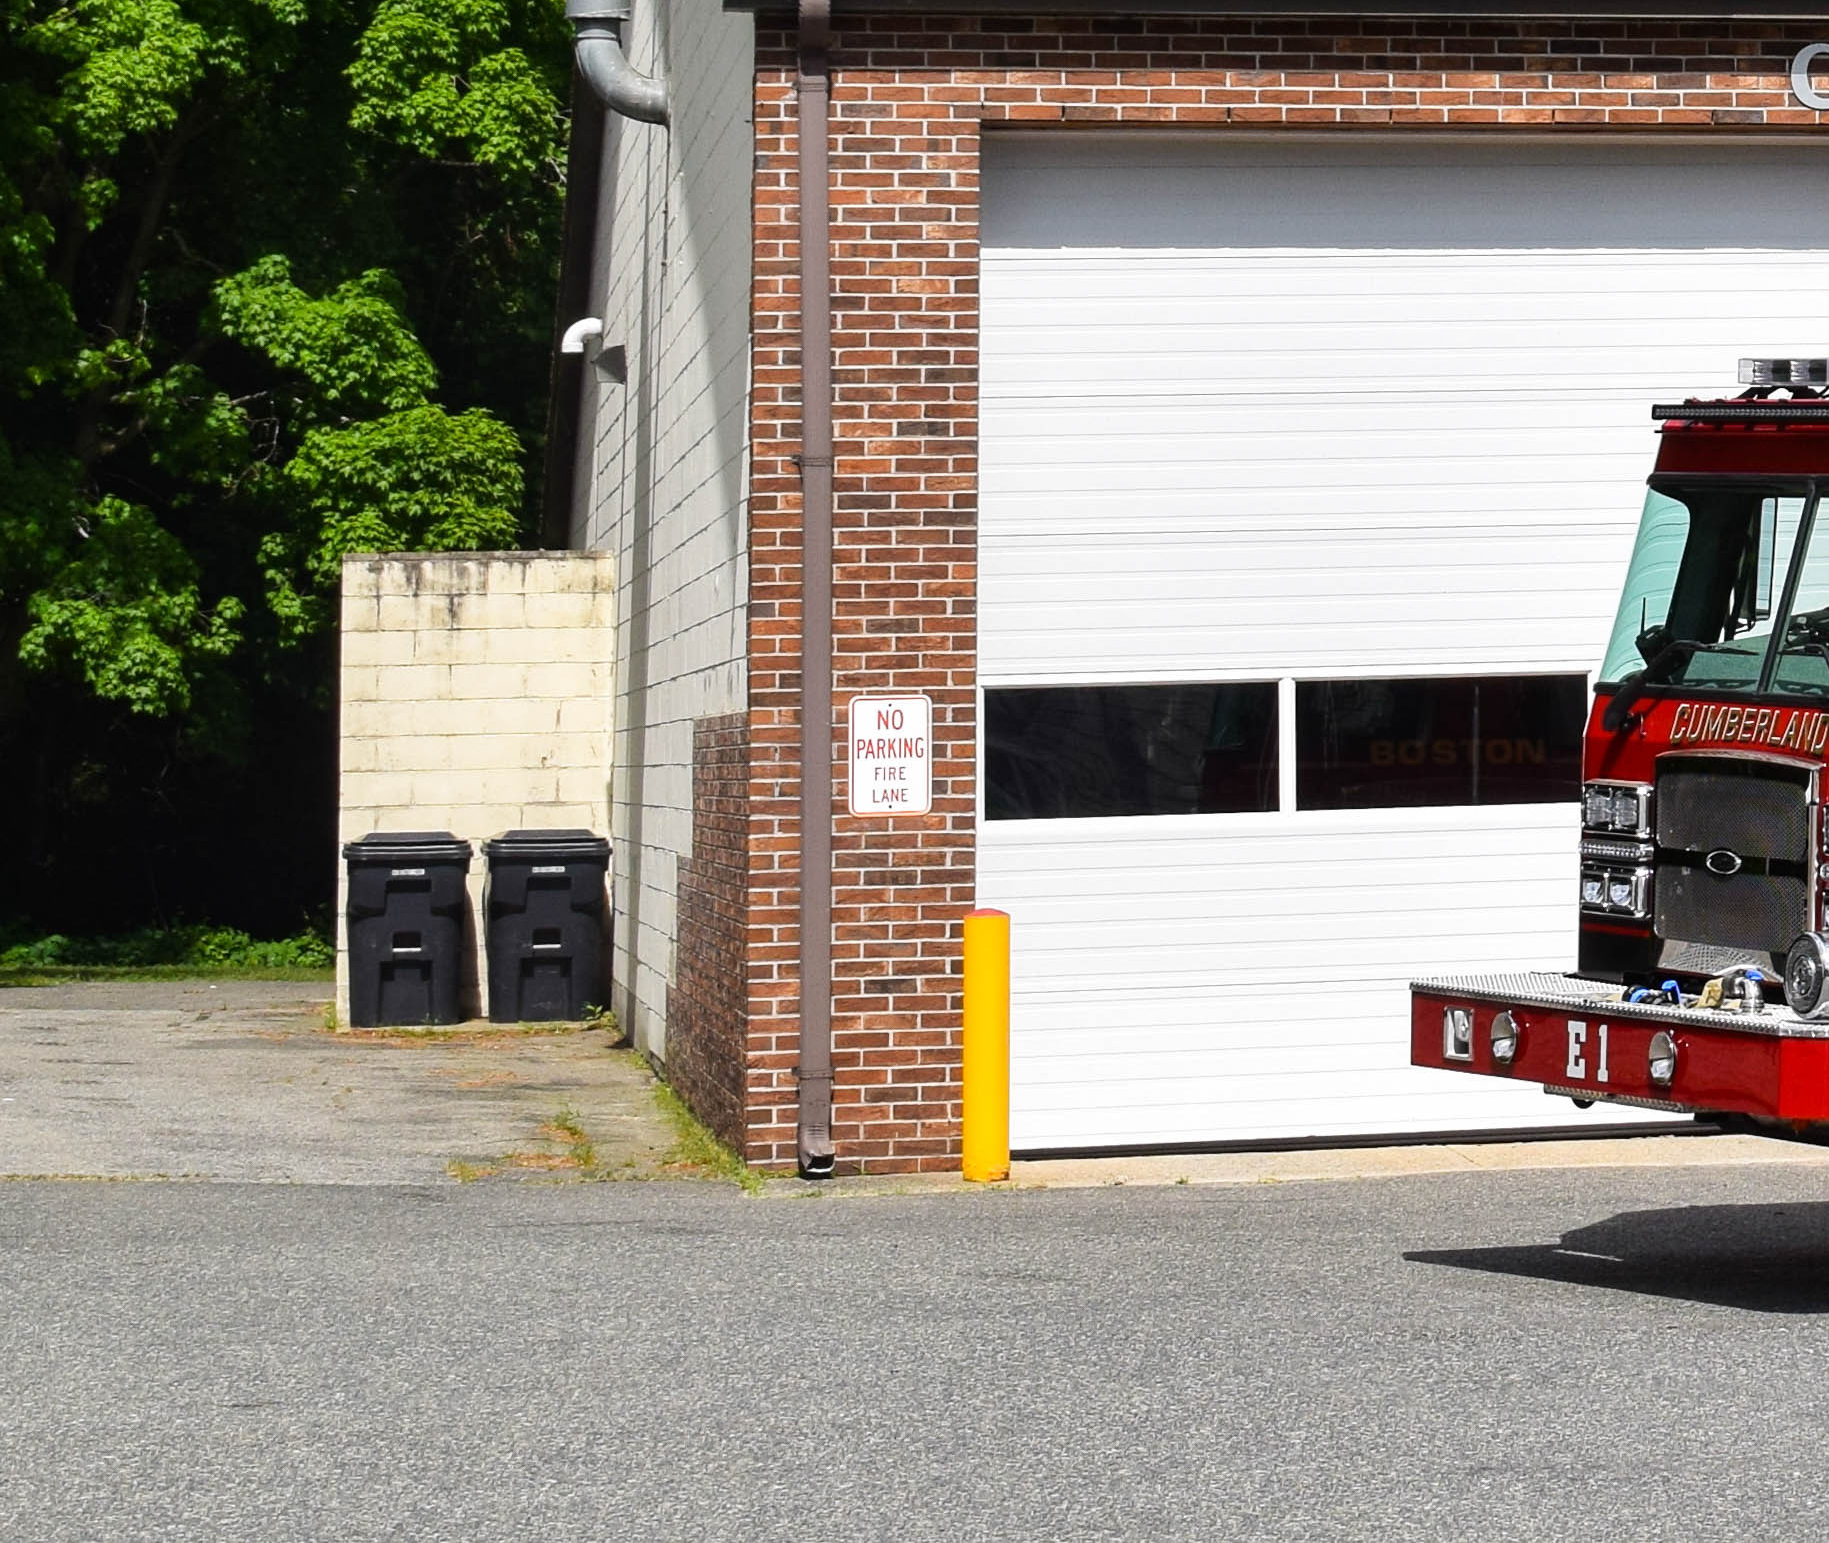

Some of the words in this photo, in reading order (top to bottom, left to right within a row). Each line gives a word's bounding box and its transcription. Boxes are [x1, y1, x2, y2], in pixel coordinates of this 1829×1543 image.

[877, 709, 904, 730] NO
[857, 737, 924, 759] PARKING
[1370, 738, 1547, 765] BOSTON
[875, 766, 907, 781] FIRE
[873, 788, 909, 803] LANE
[1566, 1020, 1610, 1083] E1
